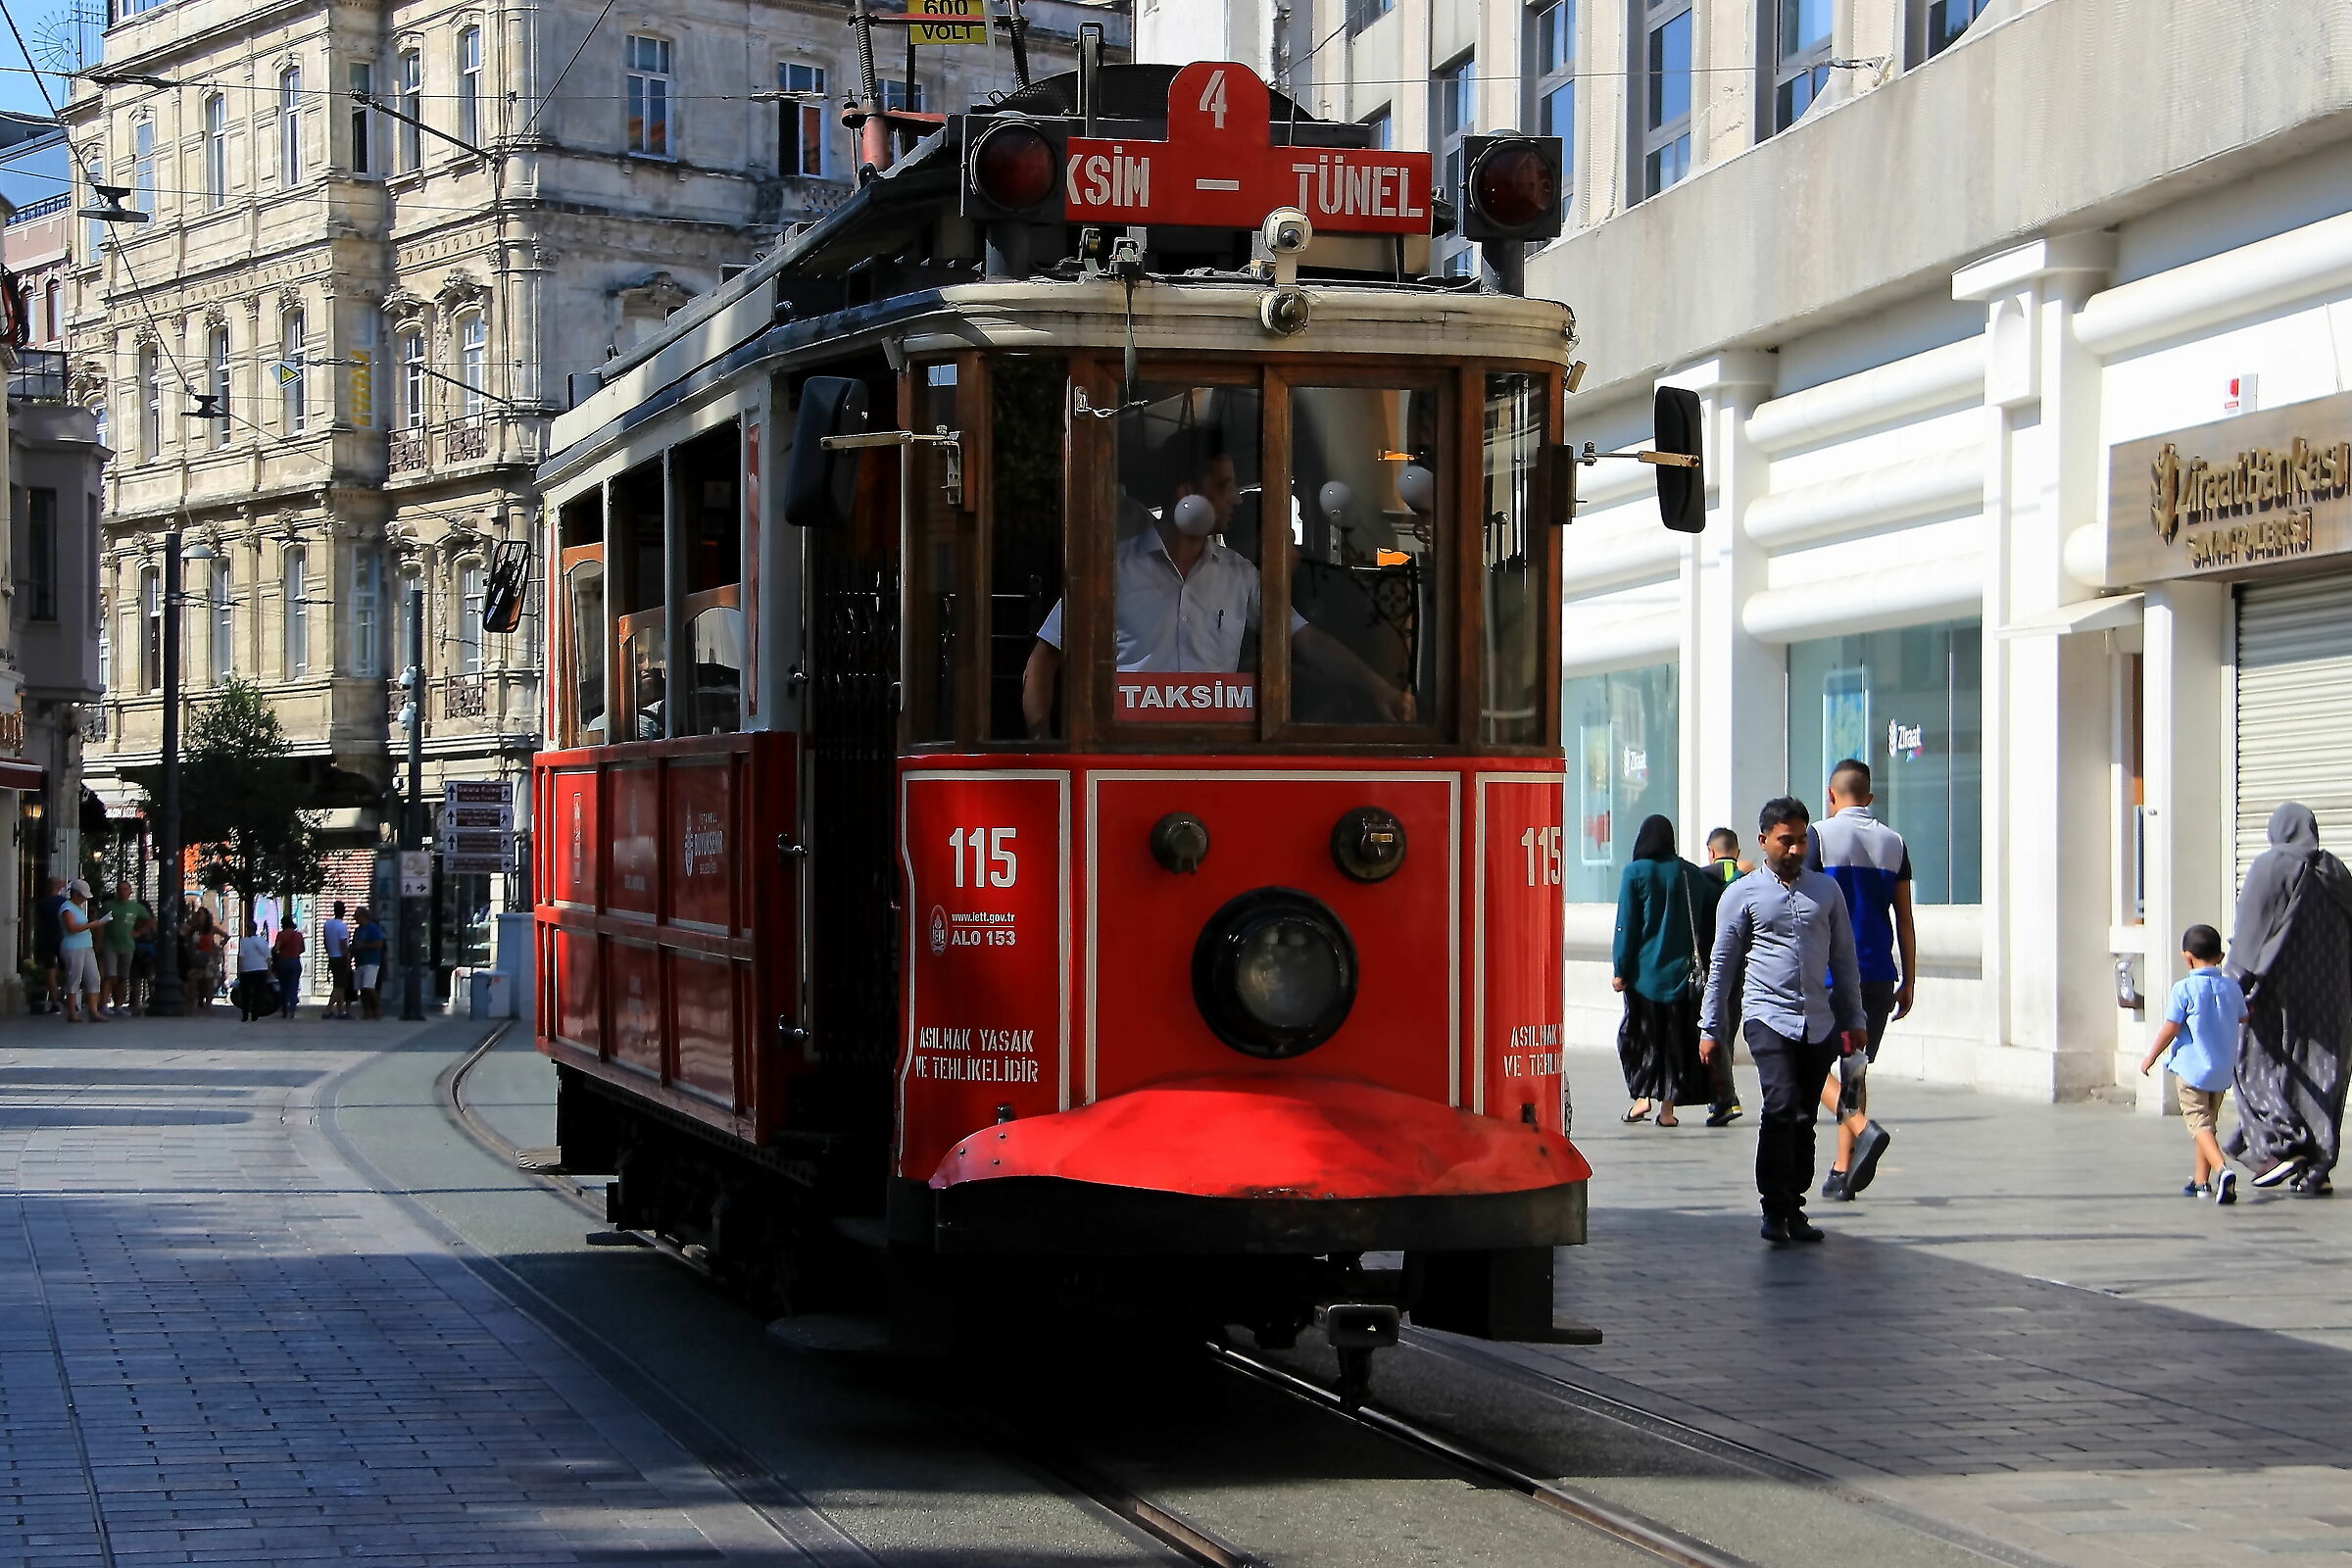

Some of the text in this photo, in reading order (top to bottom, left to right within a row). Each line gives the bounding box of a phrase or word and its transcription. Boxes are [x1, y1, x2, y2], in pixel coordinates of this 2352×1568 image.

[924, 0, 968, 15] 600
[921, 24, 971, 40] VOLT
[1199, 70, 1227, 129] 4
[1292, 155, 1423, 218] TÜNEL
[1118, 680, 1253, 709] TAKSİM
[1897, 724, 1923, 750] Ziraat
[949, 827, 1017, 888] 115
[1522, 827, 1561, 886] 115
[952, 911, 1015, 924] www.iett.gov.tr
[951, 930, 1016, 946] ALO 153
[920, 1027, 1034, 1053] ASILMAK YASAK
[1510, 1024, 1557, 1048] ASILMAK
[915, 1055, 1039, 1083] VE TEHLİKELİDİR
[1503, 1054, 1522, 1078] VE
